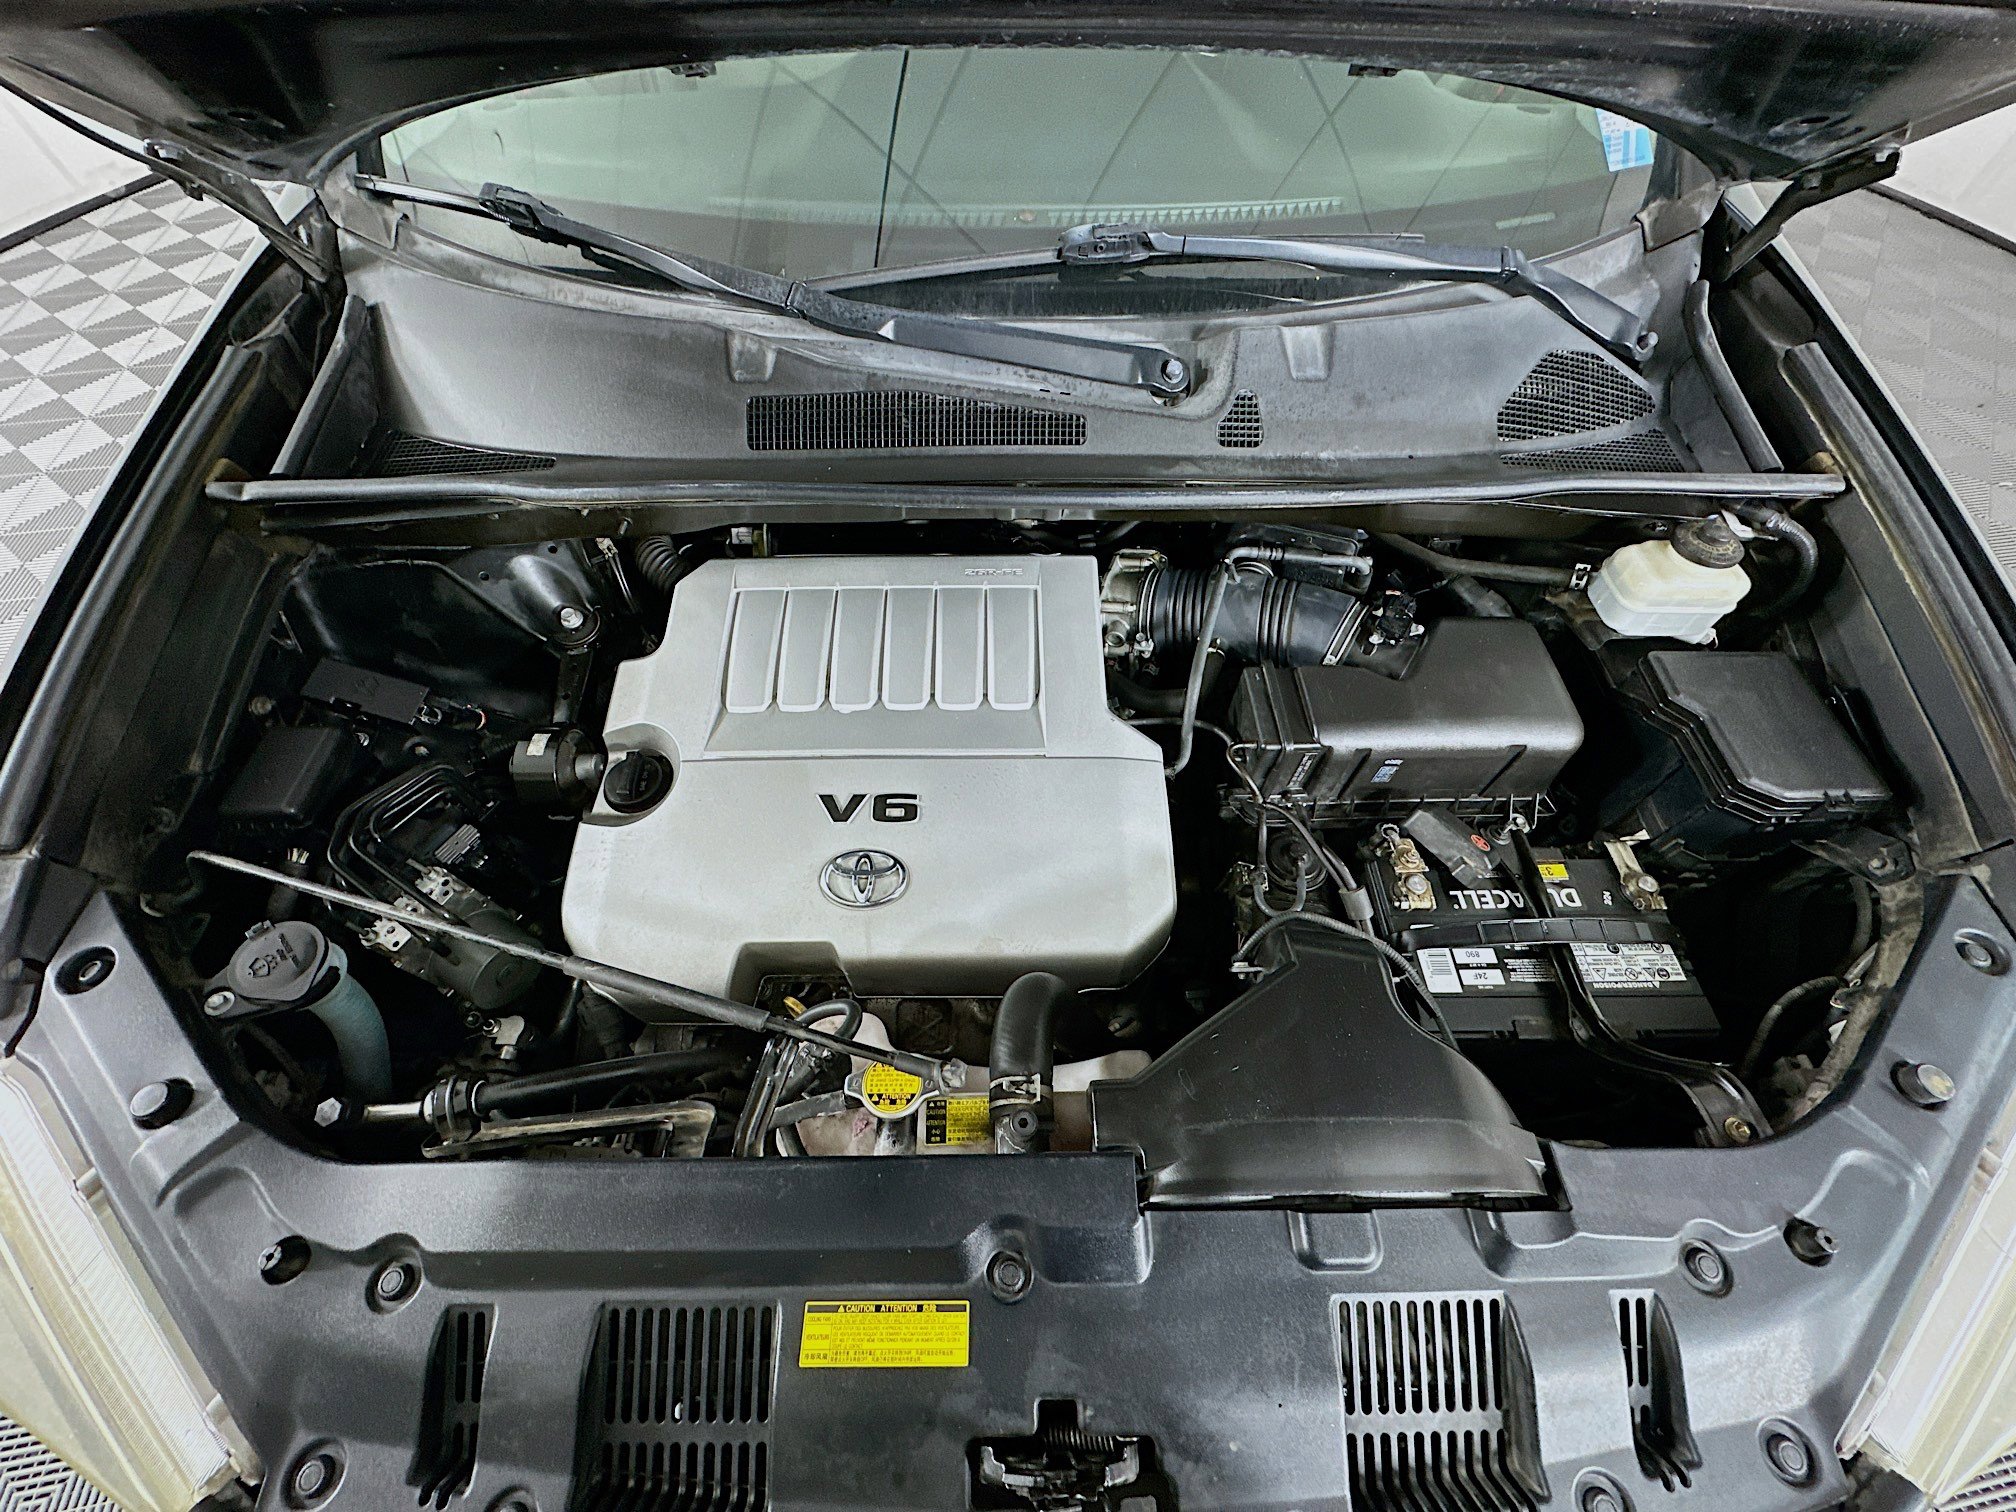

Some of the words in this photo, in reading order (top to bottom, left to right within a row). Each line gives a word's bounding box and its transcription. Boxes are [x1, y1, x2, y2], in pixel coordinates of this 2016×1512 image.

[964, 568, 1023, 576] 2GR-FE
[816, 793, 919, 823] V6
[1450, 888, 1582, 909] DUACELL
[1473, 972, 1488, 980] 24F
[845, 1304, 875, 1312] CAUTION
[880, 1304, 918, 1312] ATTENTION
